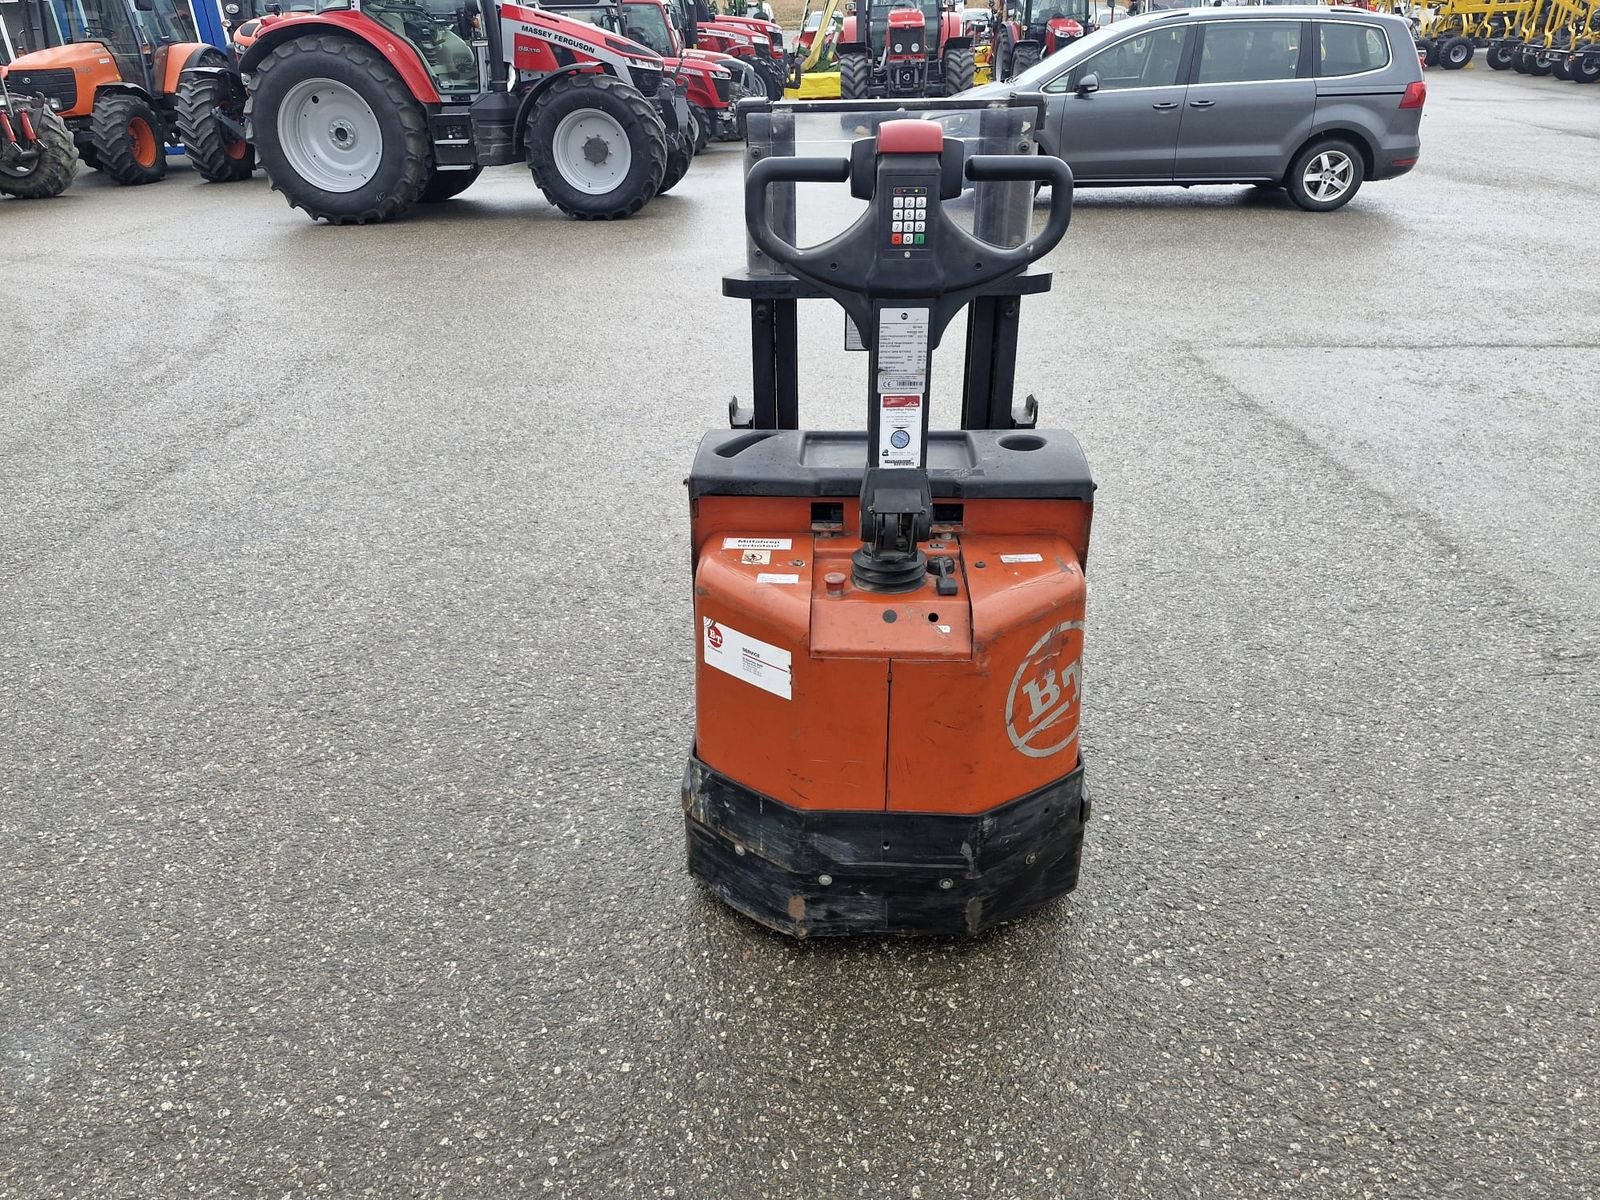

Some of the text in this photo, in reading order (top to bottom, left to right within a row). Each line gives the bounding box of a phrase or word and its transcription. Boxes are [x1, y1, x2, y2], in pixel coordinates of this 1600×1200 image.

[521, 25, 595, 54] MASSEY FERGUSON
[709, 628, 722, 644] BT
[742, 647, 760, 658] SERVICE
[1022, 660, 1082, 722] BT
